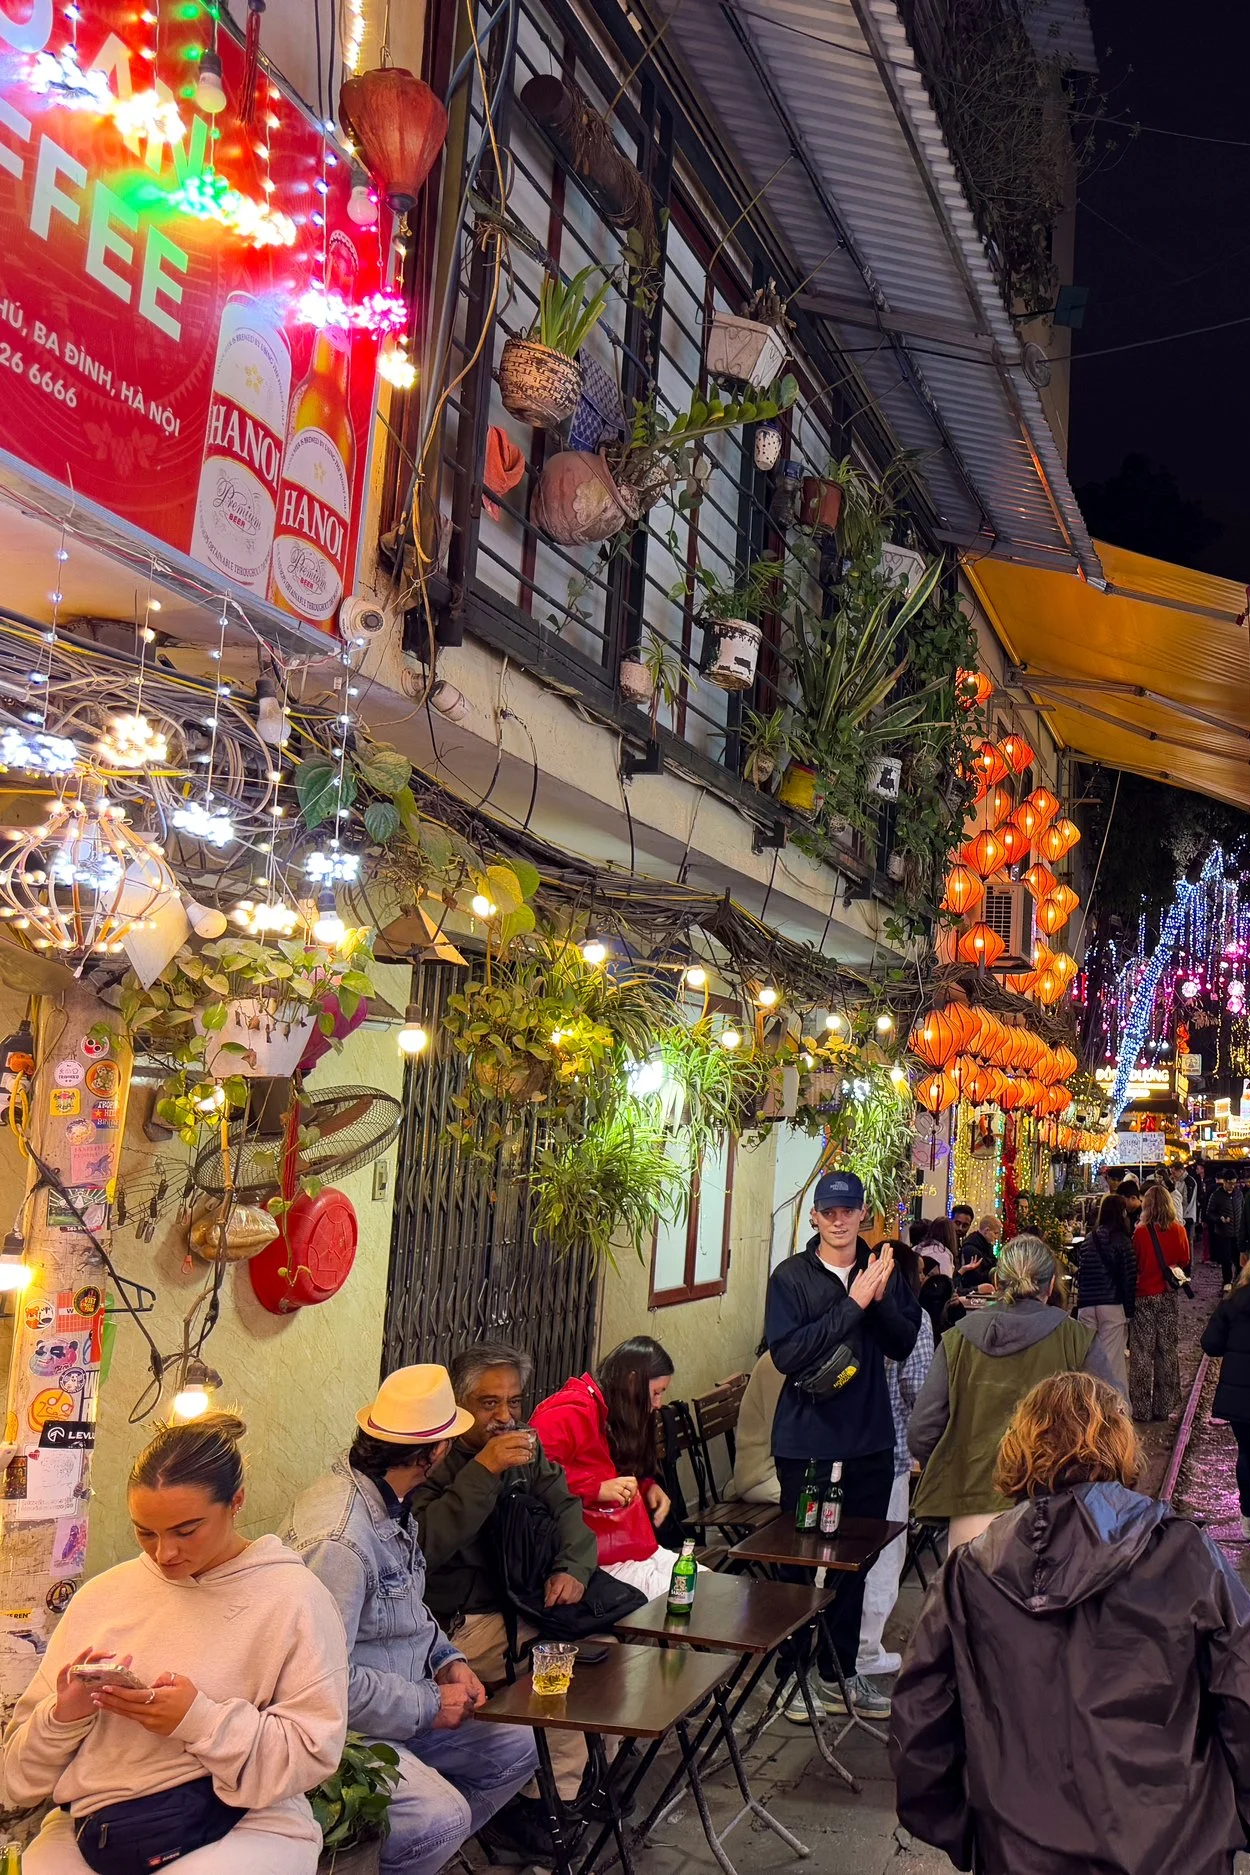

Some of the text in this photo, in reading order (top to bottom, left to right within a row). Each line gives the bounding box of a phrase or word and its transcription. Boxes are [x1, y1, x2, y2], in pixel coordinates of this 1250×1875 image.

[29, 364, 77, 408] 6666
[33, 320, 60, 356] BA
[65, 342, 116, 397] ĐÌNH,
[121, 381, 145, 415] HÀ
[149, 401, 180, 437] NỘI
[208, 404, 280, 490] HANOI
[213, 477, 263, 531] Premium
[228, 513, 246, 528] BEER
[281, 489, 344, 563] HANOI
[287, 550, 326, 592] Premium
[301, 576, 314, 590] BEER
